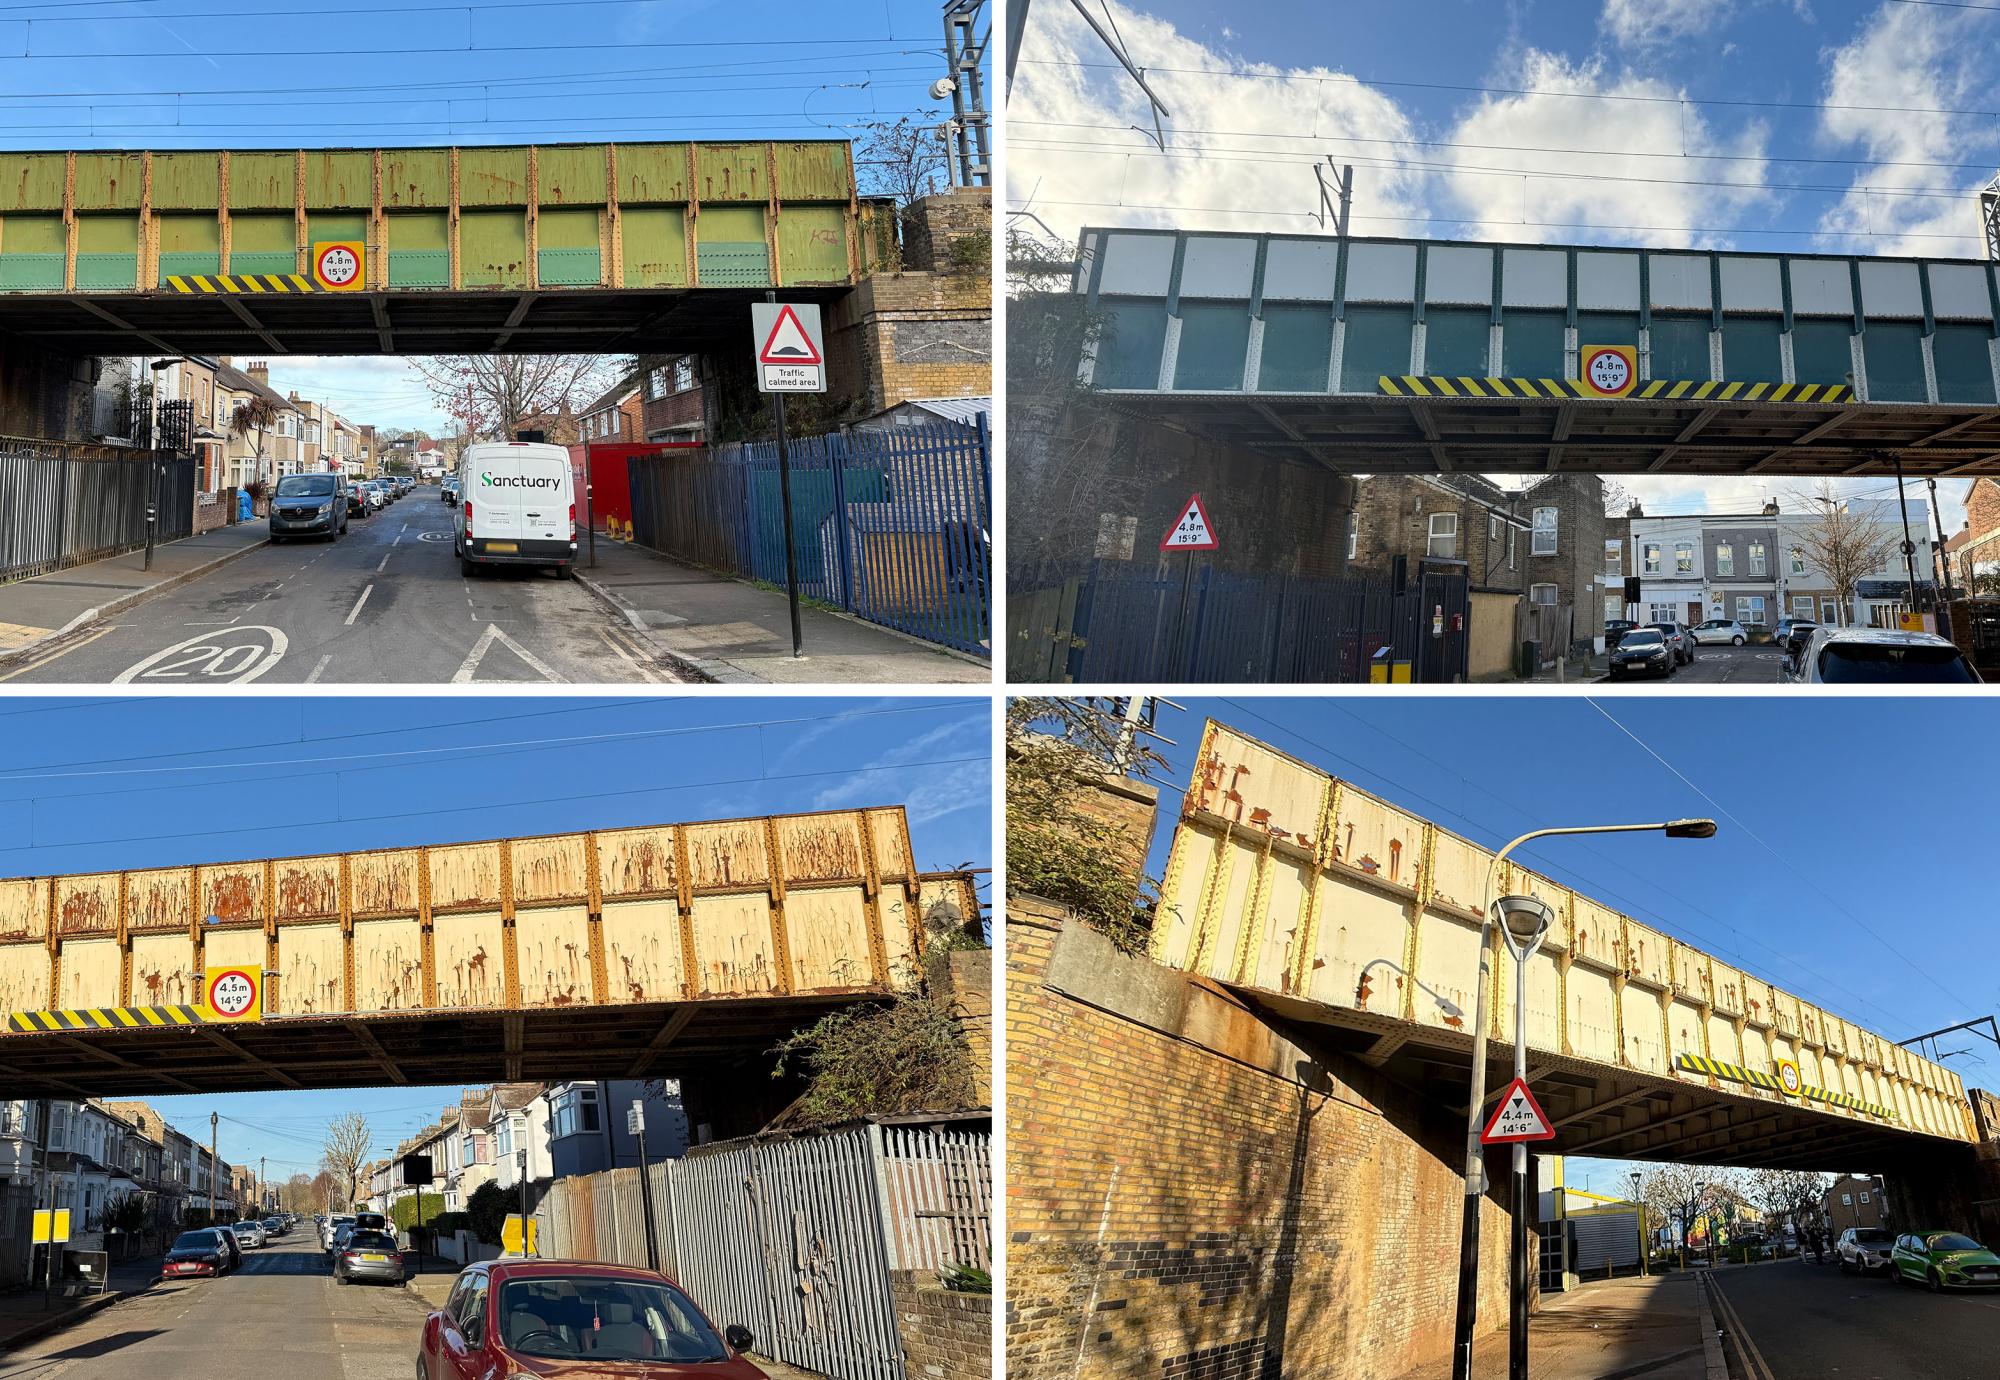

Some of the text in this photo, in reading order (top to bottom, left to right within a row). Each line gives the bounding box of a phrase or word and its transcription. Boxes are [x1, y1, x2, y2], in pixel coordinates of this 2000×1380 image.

[779, 369, 805, 377] Traffic
[768, 378, 797, 386] calmed
[481, 471, 561, 492] Sanctuary
[140, 645, 265, 678] 20
